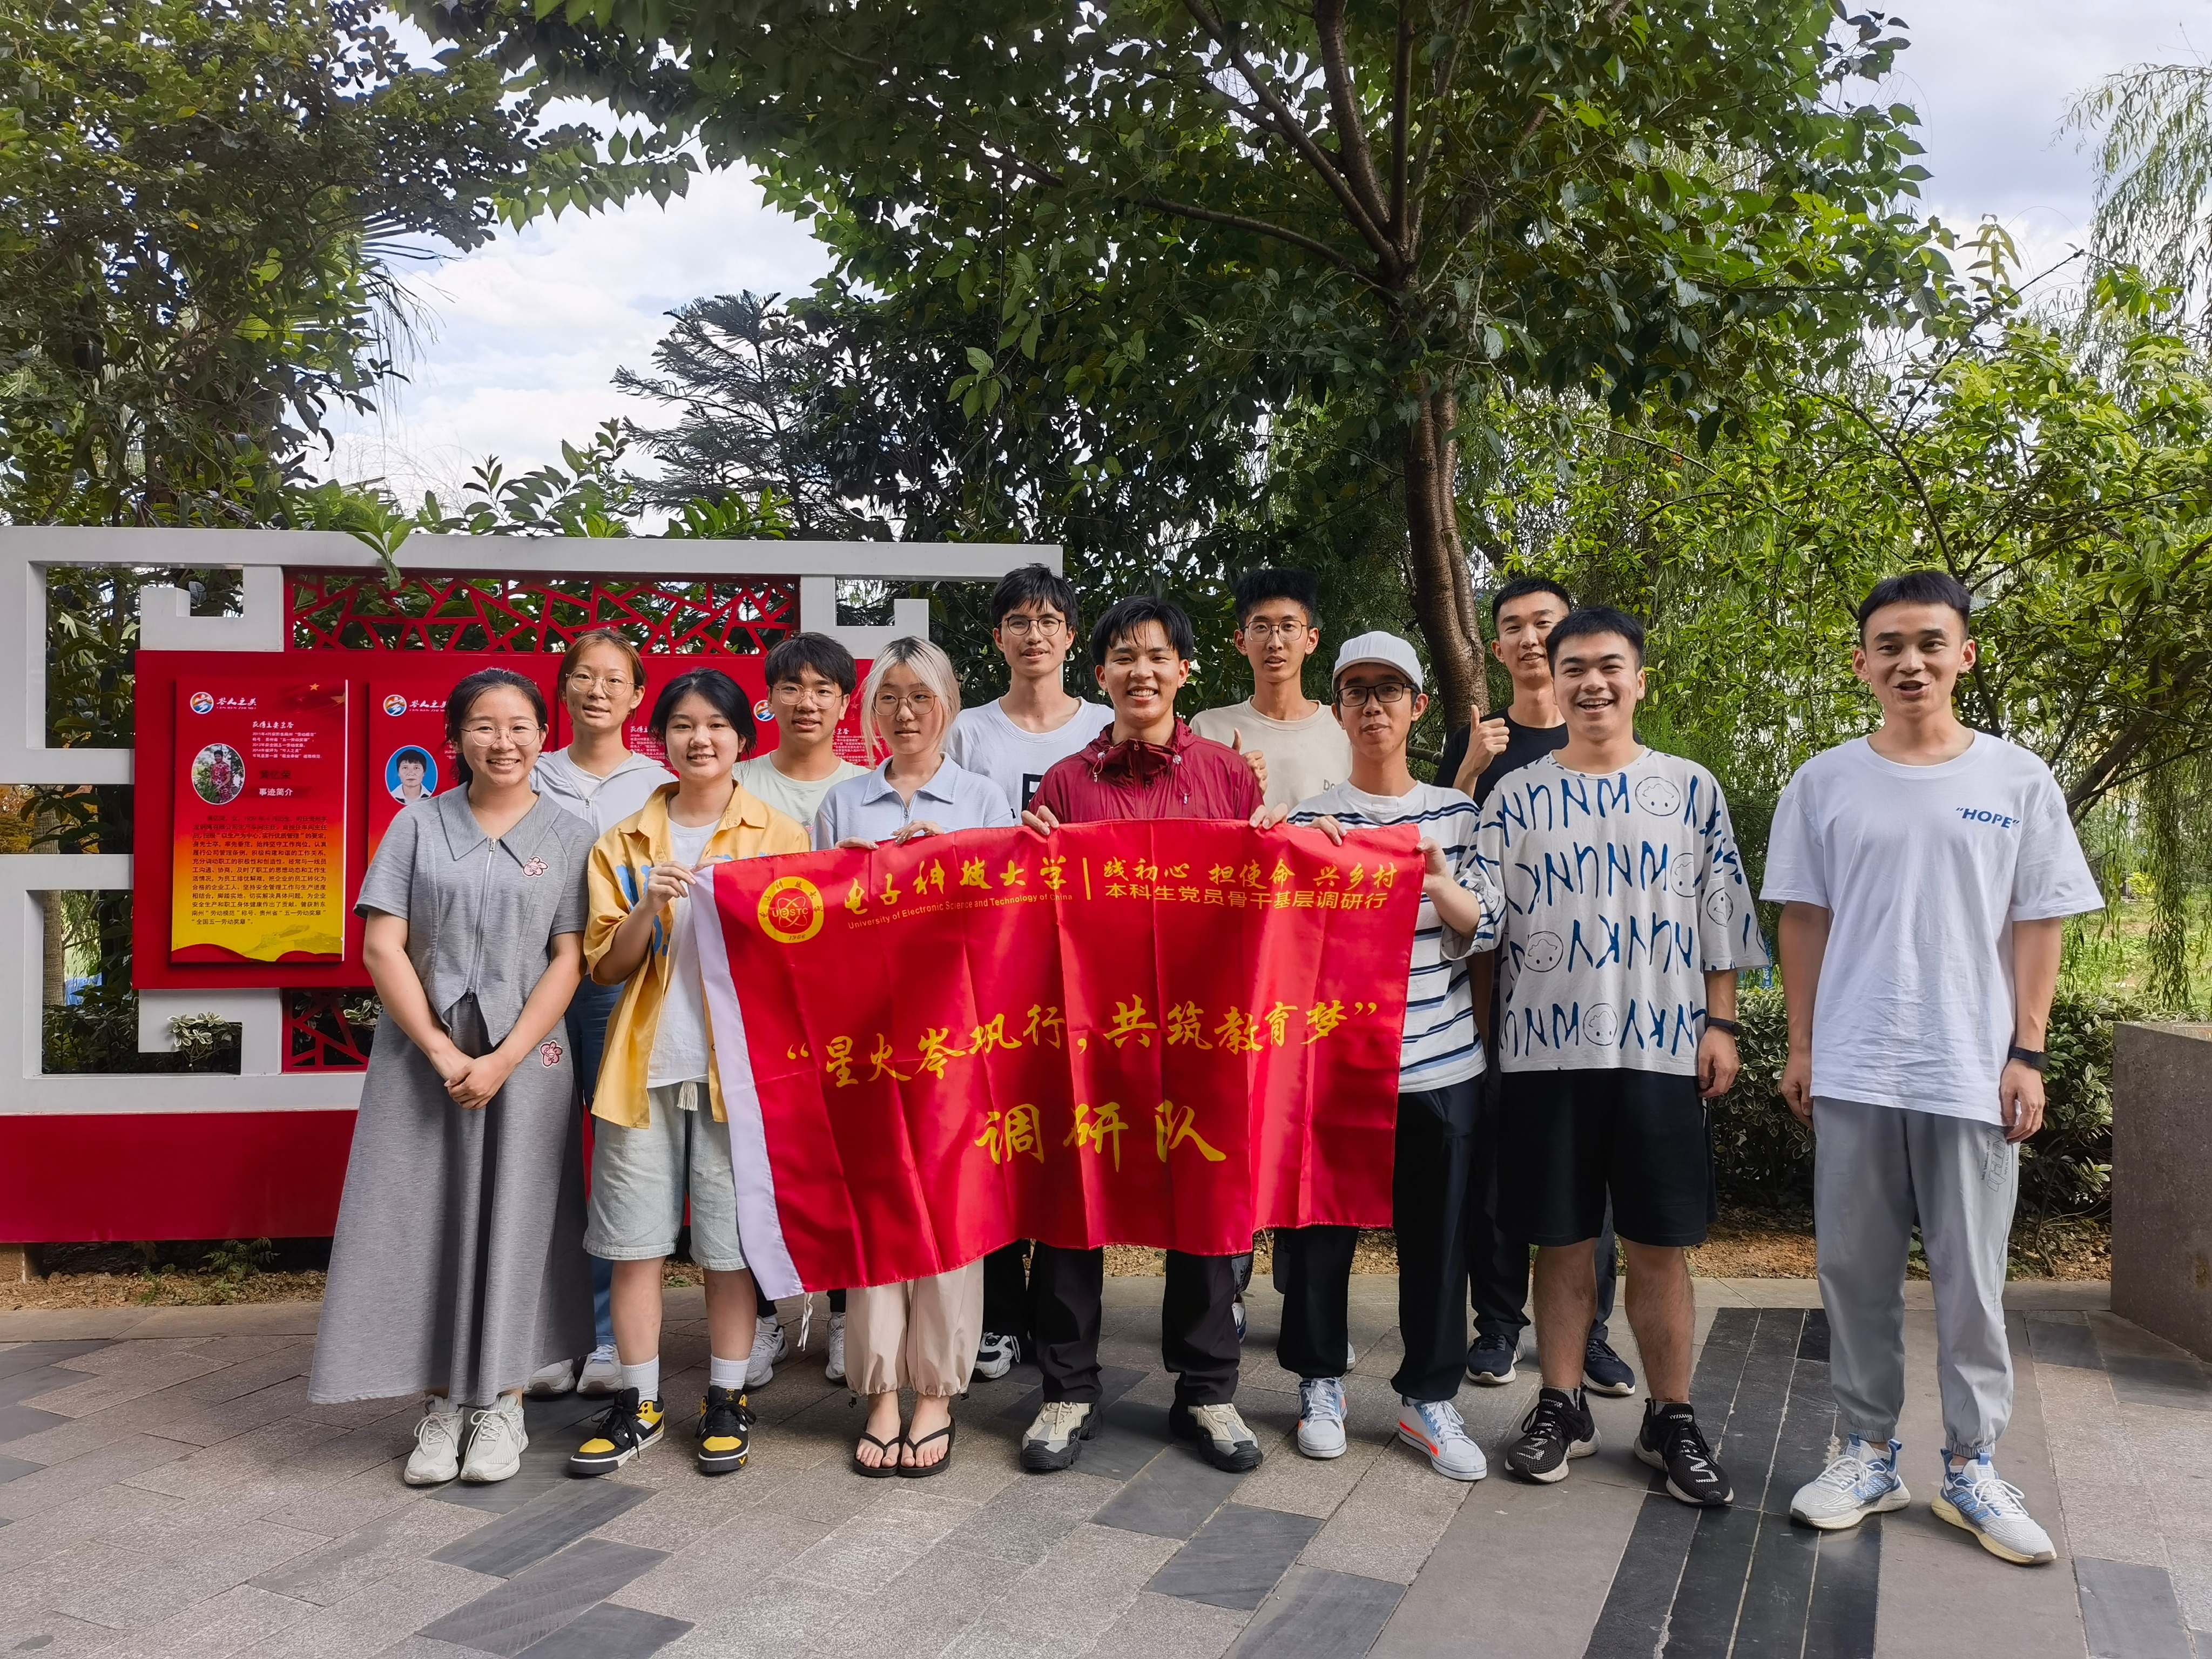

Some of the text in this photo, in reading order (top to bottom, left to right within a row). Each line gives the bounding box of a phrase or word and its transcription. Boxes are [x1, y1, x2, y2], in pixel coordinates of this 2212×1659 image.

[259, 788, 293, 796] 事迹简介
[260, 770, 291, 779] 黄亿荣
[844, 855, 1067, 915] 电子科技大学
[1103, 856, 1398, 891] 践初心 担使命 兴乡村
[848, 893, 1073, 929] University of Electronic Science and Technology of China
[1105, 883, 1388, 909] 本科生党员骨干基层调研行
[975, 1100, 1226, 1172] 调研队
